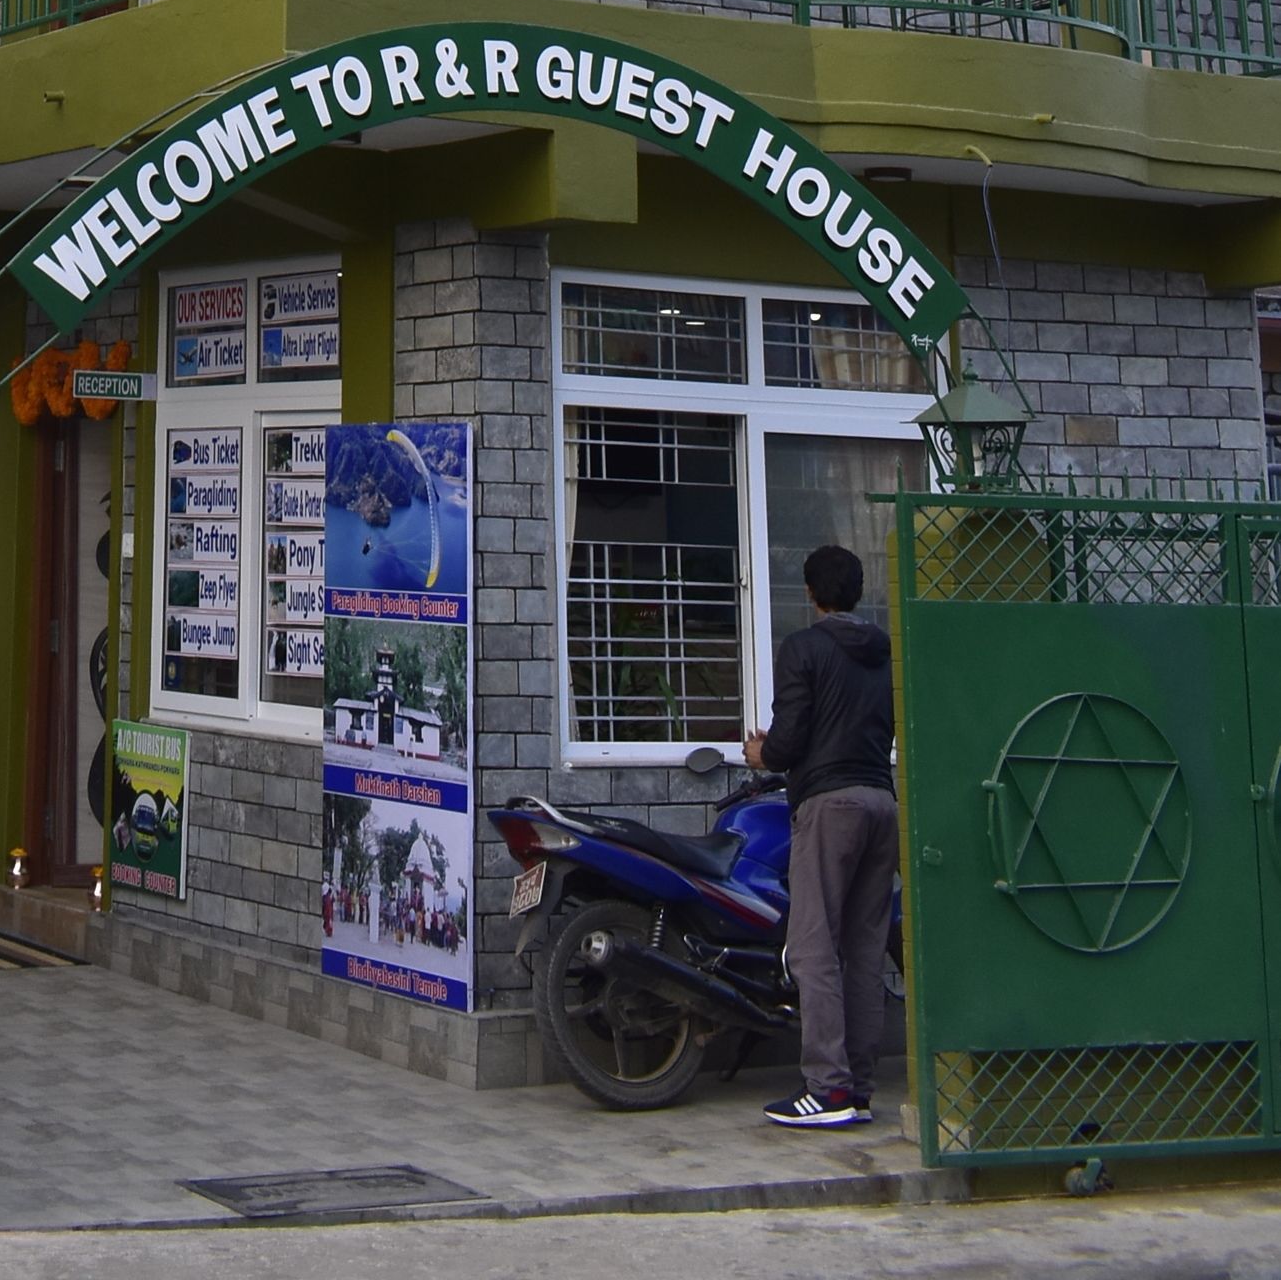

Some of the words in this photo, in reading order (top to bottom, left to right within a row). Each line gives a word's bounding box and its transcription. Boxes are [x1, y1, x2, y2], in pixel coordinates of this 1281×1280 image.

[33, 86, 297, 302] WELCOME
[290, 56, 373, 128] TO
[380, 45, 425, 106] R
[434, 38, 475, 98] &
[483, 40, 519, 94] R
[536, 45, 735, 148] GUEST
[743, 128, 936, 320] HOUSE
[177, 294, 197, 325] OUR
[198, 287, 244, 323] SERVICES
[278, 285, 306, 314] Vehicle
[306, 281, 336, 310] Service
[198, 344, 212, 368] Air
[214, 339, 244, 367] Ticket
[298, 335, 316, 361] Light
[318, 334, 337, 362] Flight
[77, 375, 139, 396] RECEPTION
[193, 438, 209, 465] Bus
[212, 437, 239, 465] Ticket
[188, 481, 237, 514] Paragliding
[284, 489, 299, 518] Guide
[299, 493, 304, 517] &
[305, 491, 322, 518] Porter
[195, 525, 237, 561] Rafting
[290, 539, 316, 575] Pony
[200, 574, 218, 608] Zeep
[219, 572, 237, 609] Flyer
[288, 583, 316, 619] Jungle
[331, 591, 382, 617] Paragliding
[382, 592, 420, 620] Booking
[421, 595, 459, 619] Counter
[183, 618, 211, 652] Bungee
[212, 620, 236, 653] Jump
[288, 632, 311, 671] Sight
[117, 728, 132, 753] A/C
[133, 730, 165, 759] TOURIST
[165, 736, 182, 762] BUS
[355, 772, 401, 800] Muktinath
[402, 779, 442, 807] Darshan
[111, 861, 142, 887] BOOKING
[144, 868, 177, 897] COUNTER
[347, 955, 411, 993] Bindhyabasini
[412, 972, 448, 1005] Temple
